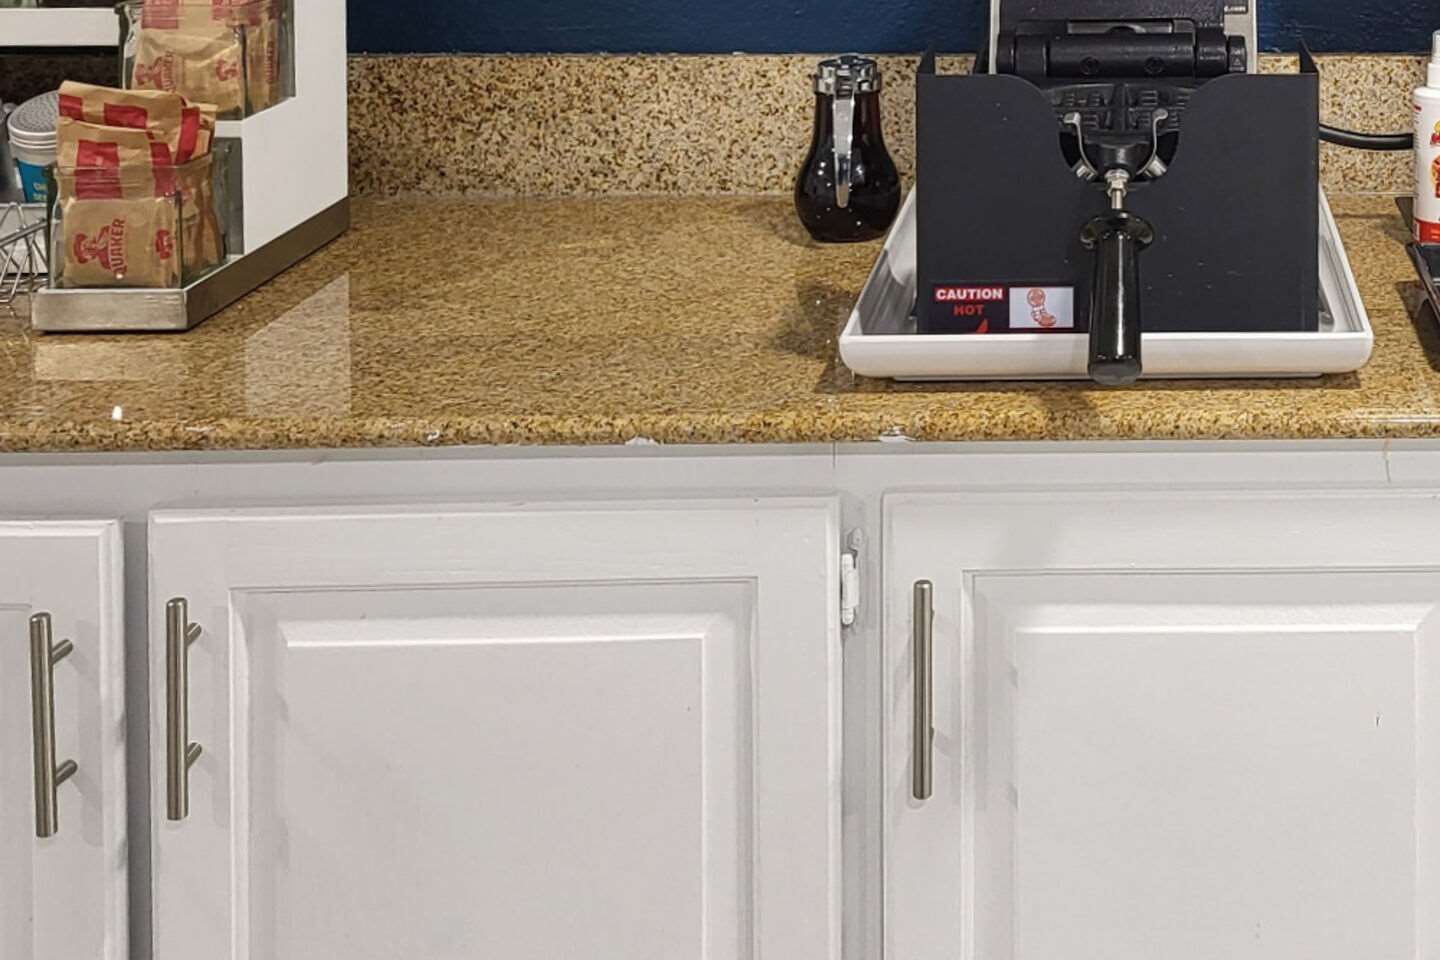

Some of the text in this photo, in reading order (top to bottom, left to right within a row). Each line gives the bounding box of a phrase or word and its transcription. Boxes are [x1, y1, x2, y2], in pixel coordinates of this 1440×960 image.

[111, 217, 128, 278] QUAKER
[935, 288, 1003, 301] CAUTION
[953, 304, 985, 317] HOT
